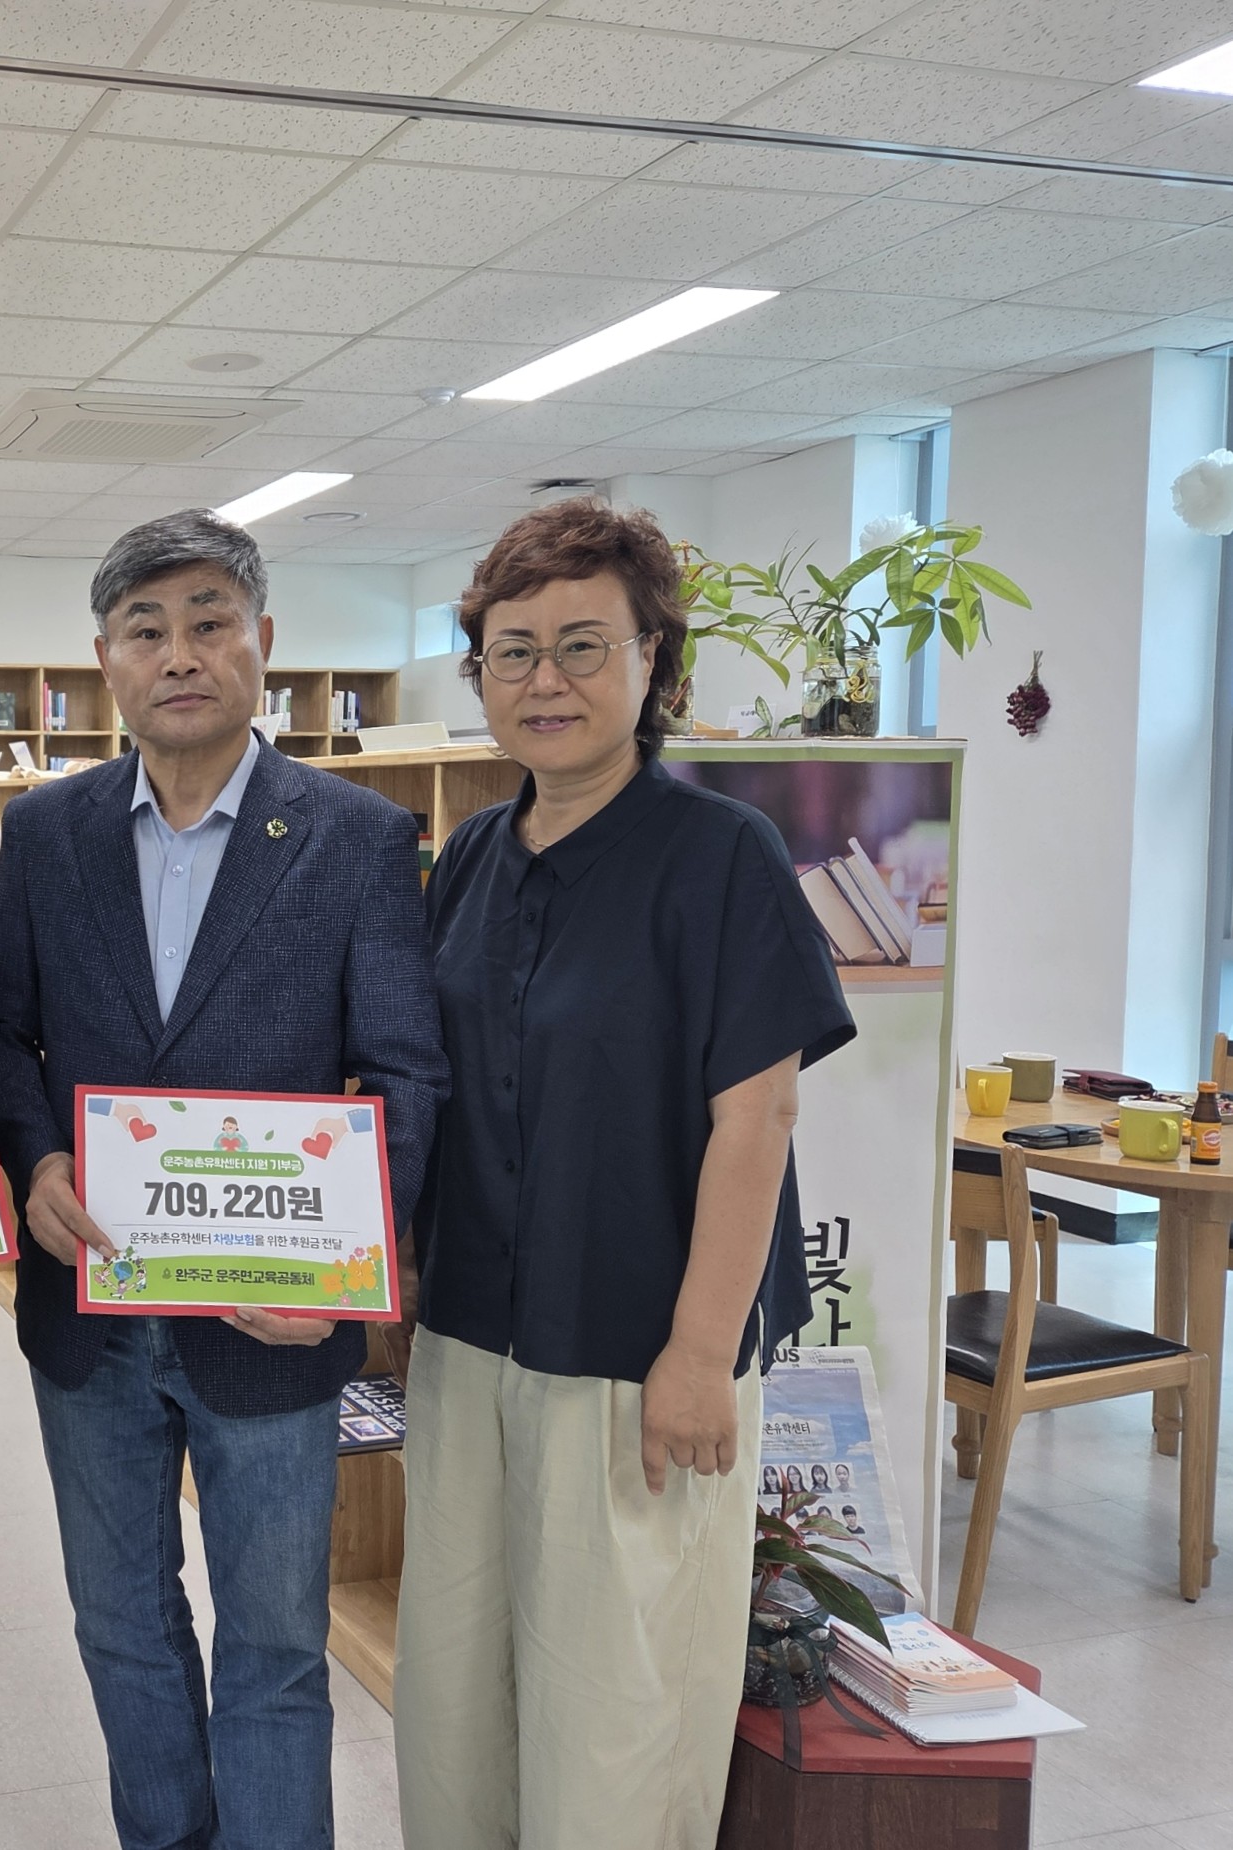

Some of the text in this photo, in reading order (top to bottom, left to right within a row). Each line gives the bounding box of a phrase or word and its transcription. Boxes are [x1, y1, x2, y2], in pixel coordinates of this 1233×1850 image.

[163, 1156, 302, 1171] 운주농촌유학센터 지원 기부금
[144, 1182, 323, 1222] 709,220원
[129, 1232, 342, 1250] 운주농촌유학센터 차량보험을 위한 후원금 전달
[175, 1268, 314, 1286] 완주군 운주면교육공동체
[771, 1347, 800, 1364] US
[349, 1382, 406, 1424] MUSEU
[762, 1421, 811, 1436] 촌유학센터
